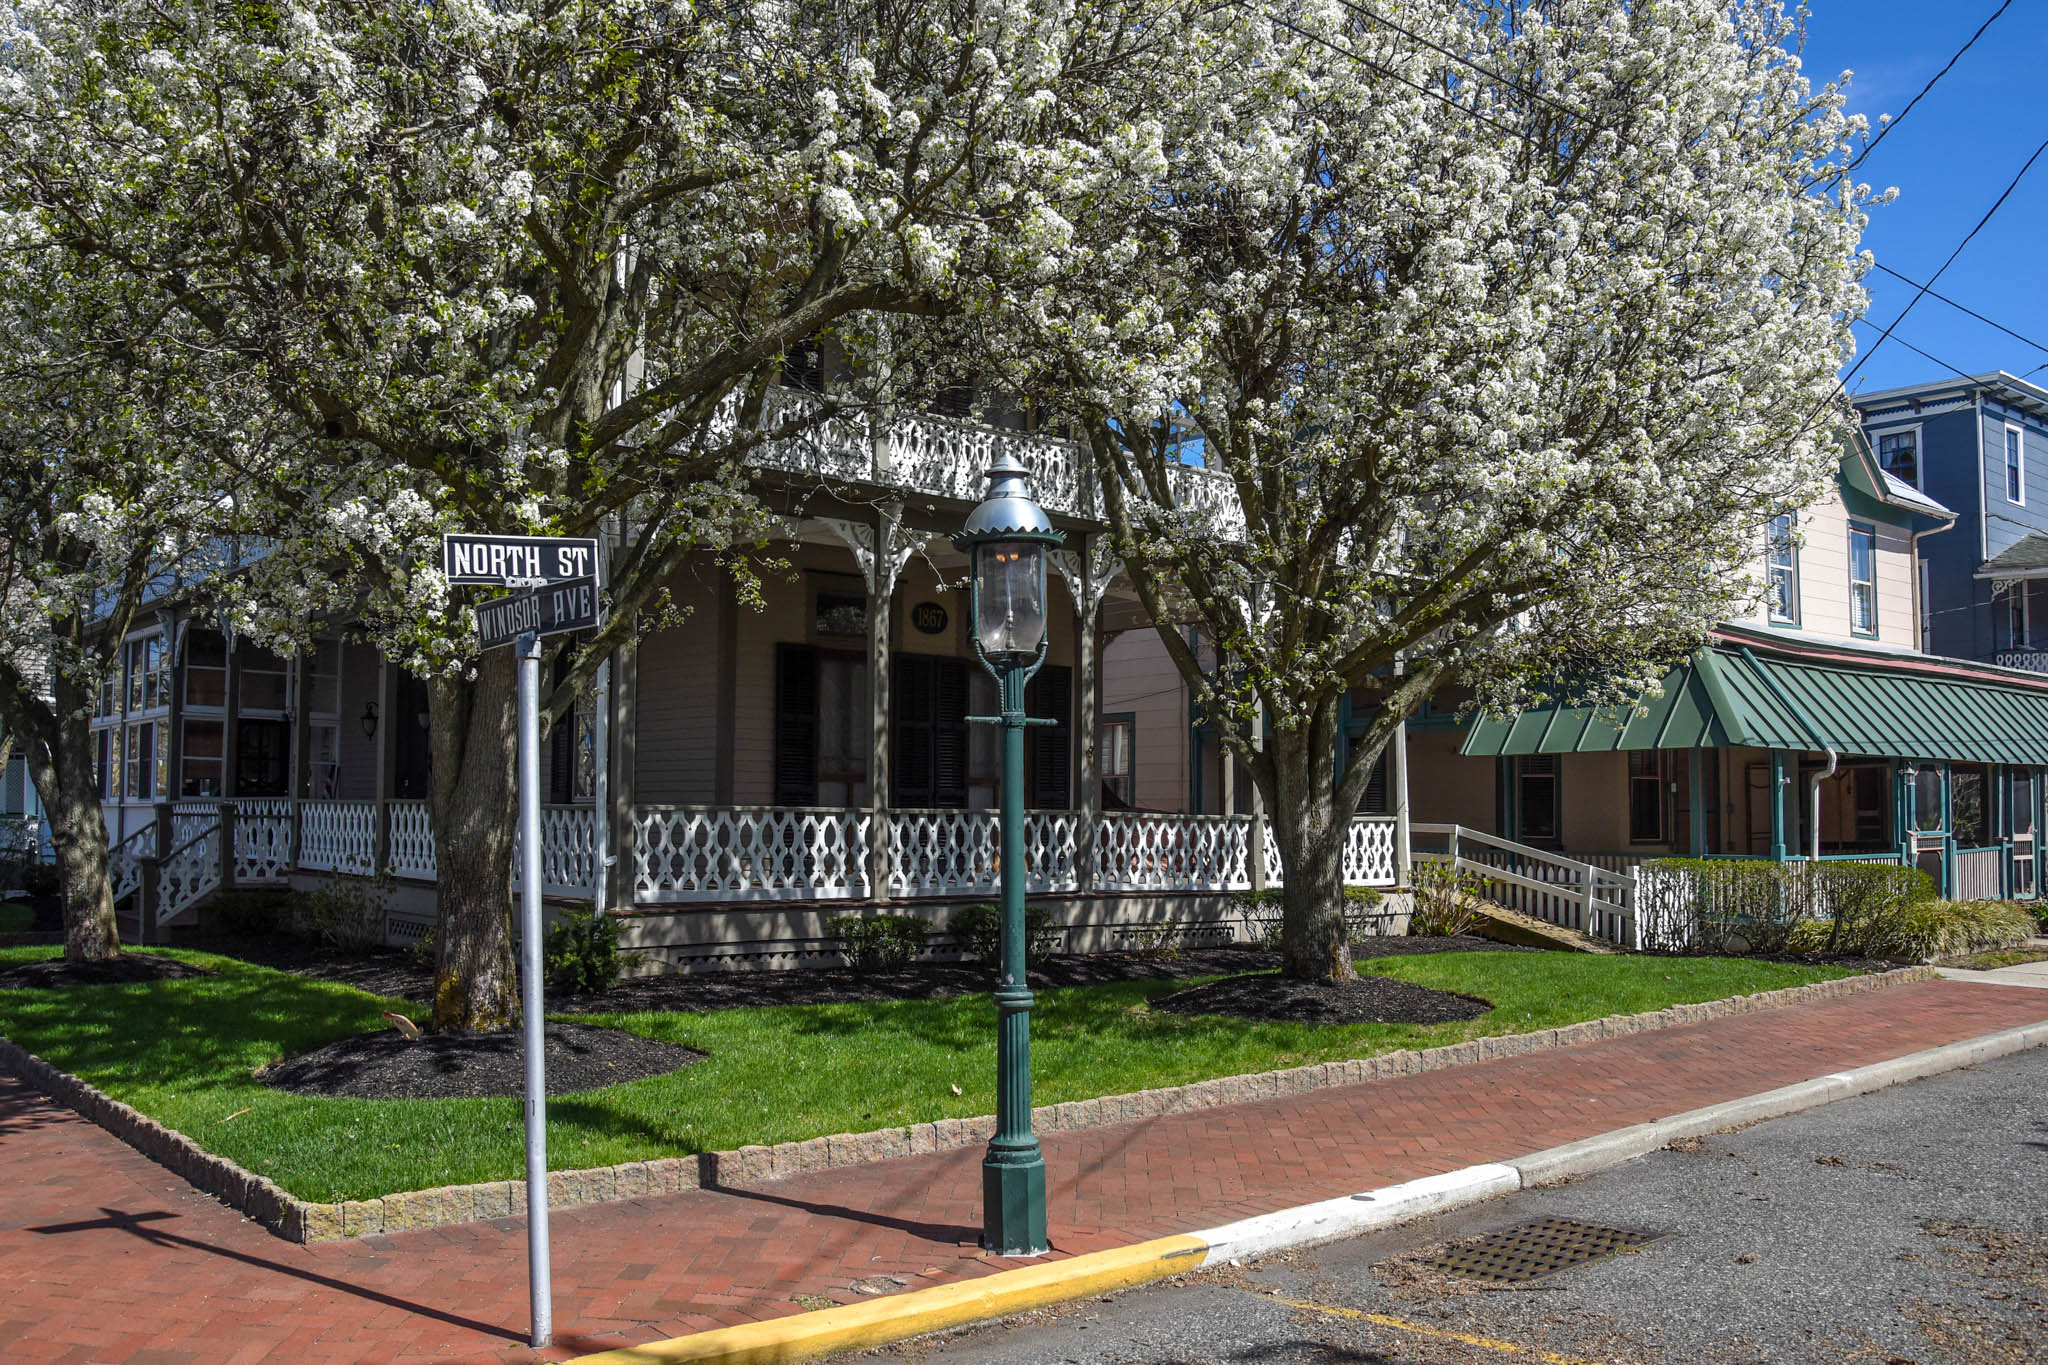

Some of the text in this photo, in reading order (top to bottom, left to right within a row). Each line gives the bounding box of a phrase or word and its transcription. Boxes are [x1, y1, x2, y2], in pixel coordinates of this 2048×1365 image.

[453, 543, 588, 579] NORTH ST
[480, 585, 591, 641] WINDSOR AVE
[919, 607, 944, 628] 1867
